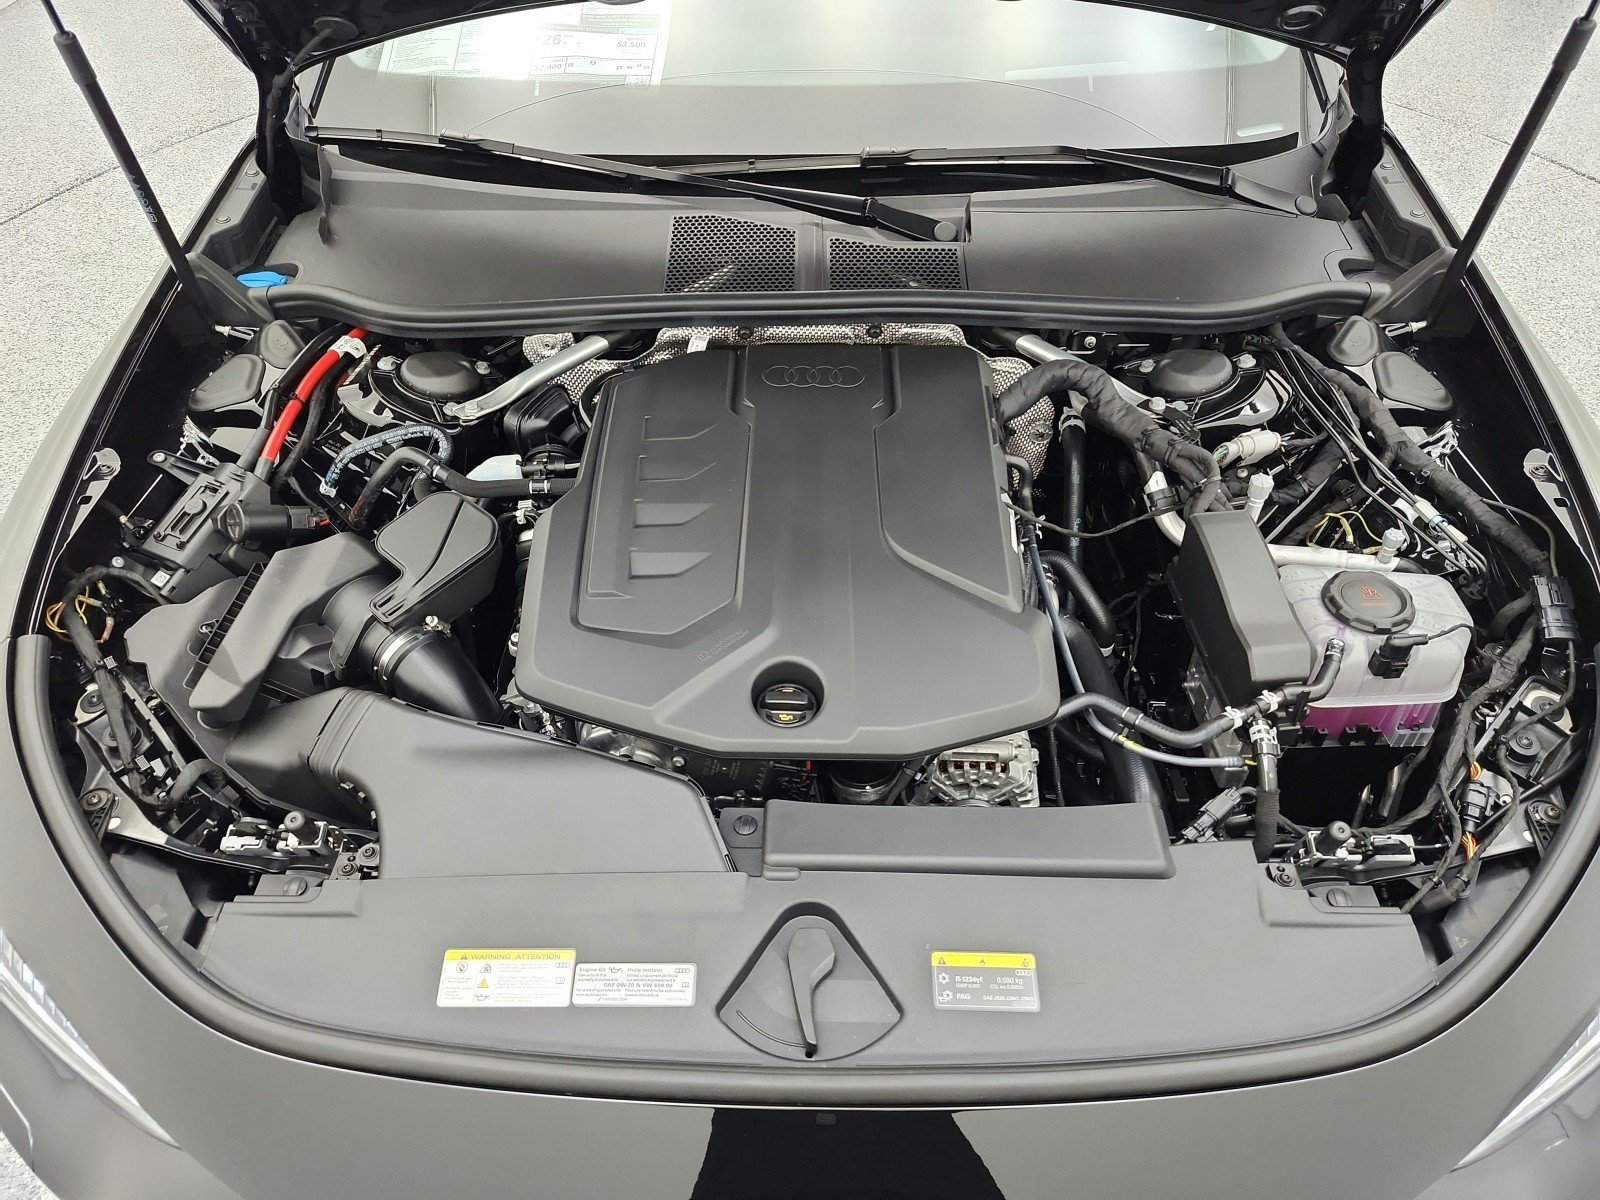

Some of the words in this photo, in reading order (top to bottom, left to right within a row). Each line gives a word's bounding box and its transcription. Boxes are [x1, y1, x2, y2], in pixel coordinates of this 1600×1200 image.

[542, 34, 562, 46] 26
[955, 975, 983, 983] R-1234yf
[1015, 977, 1023, 985] kg
